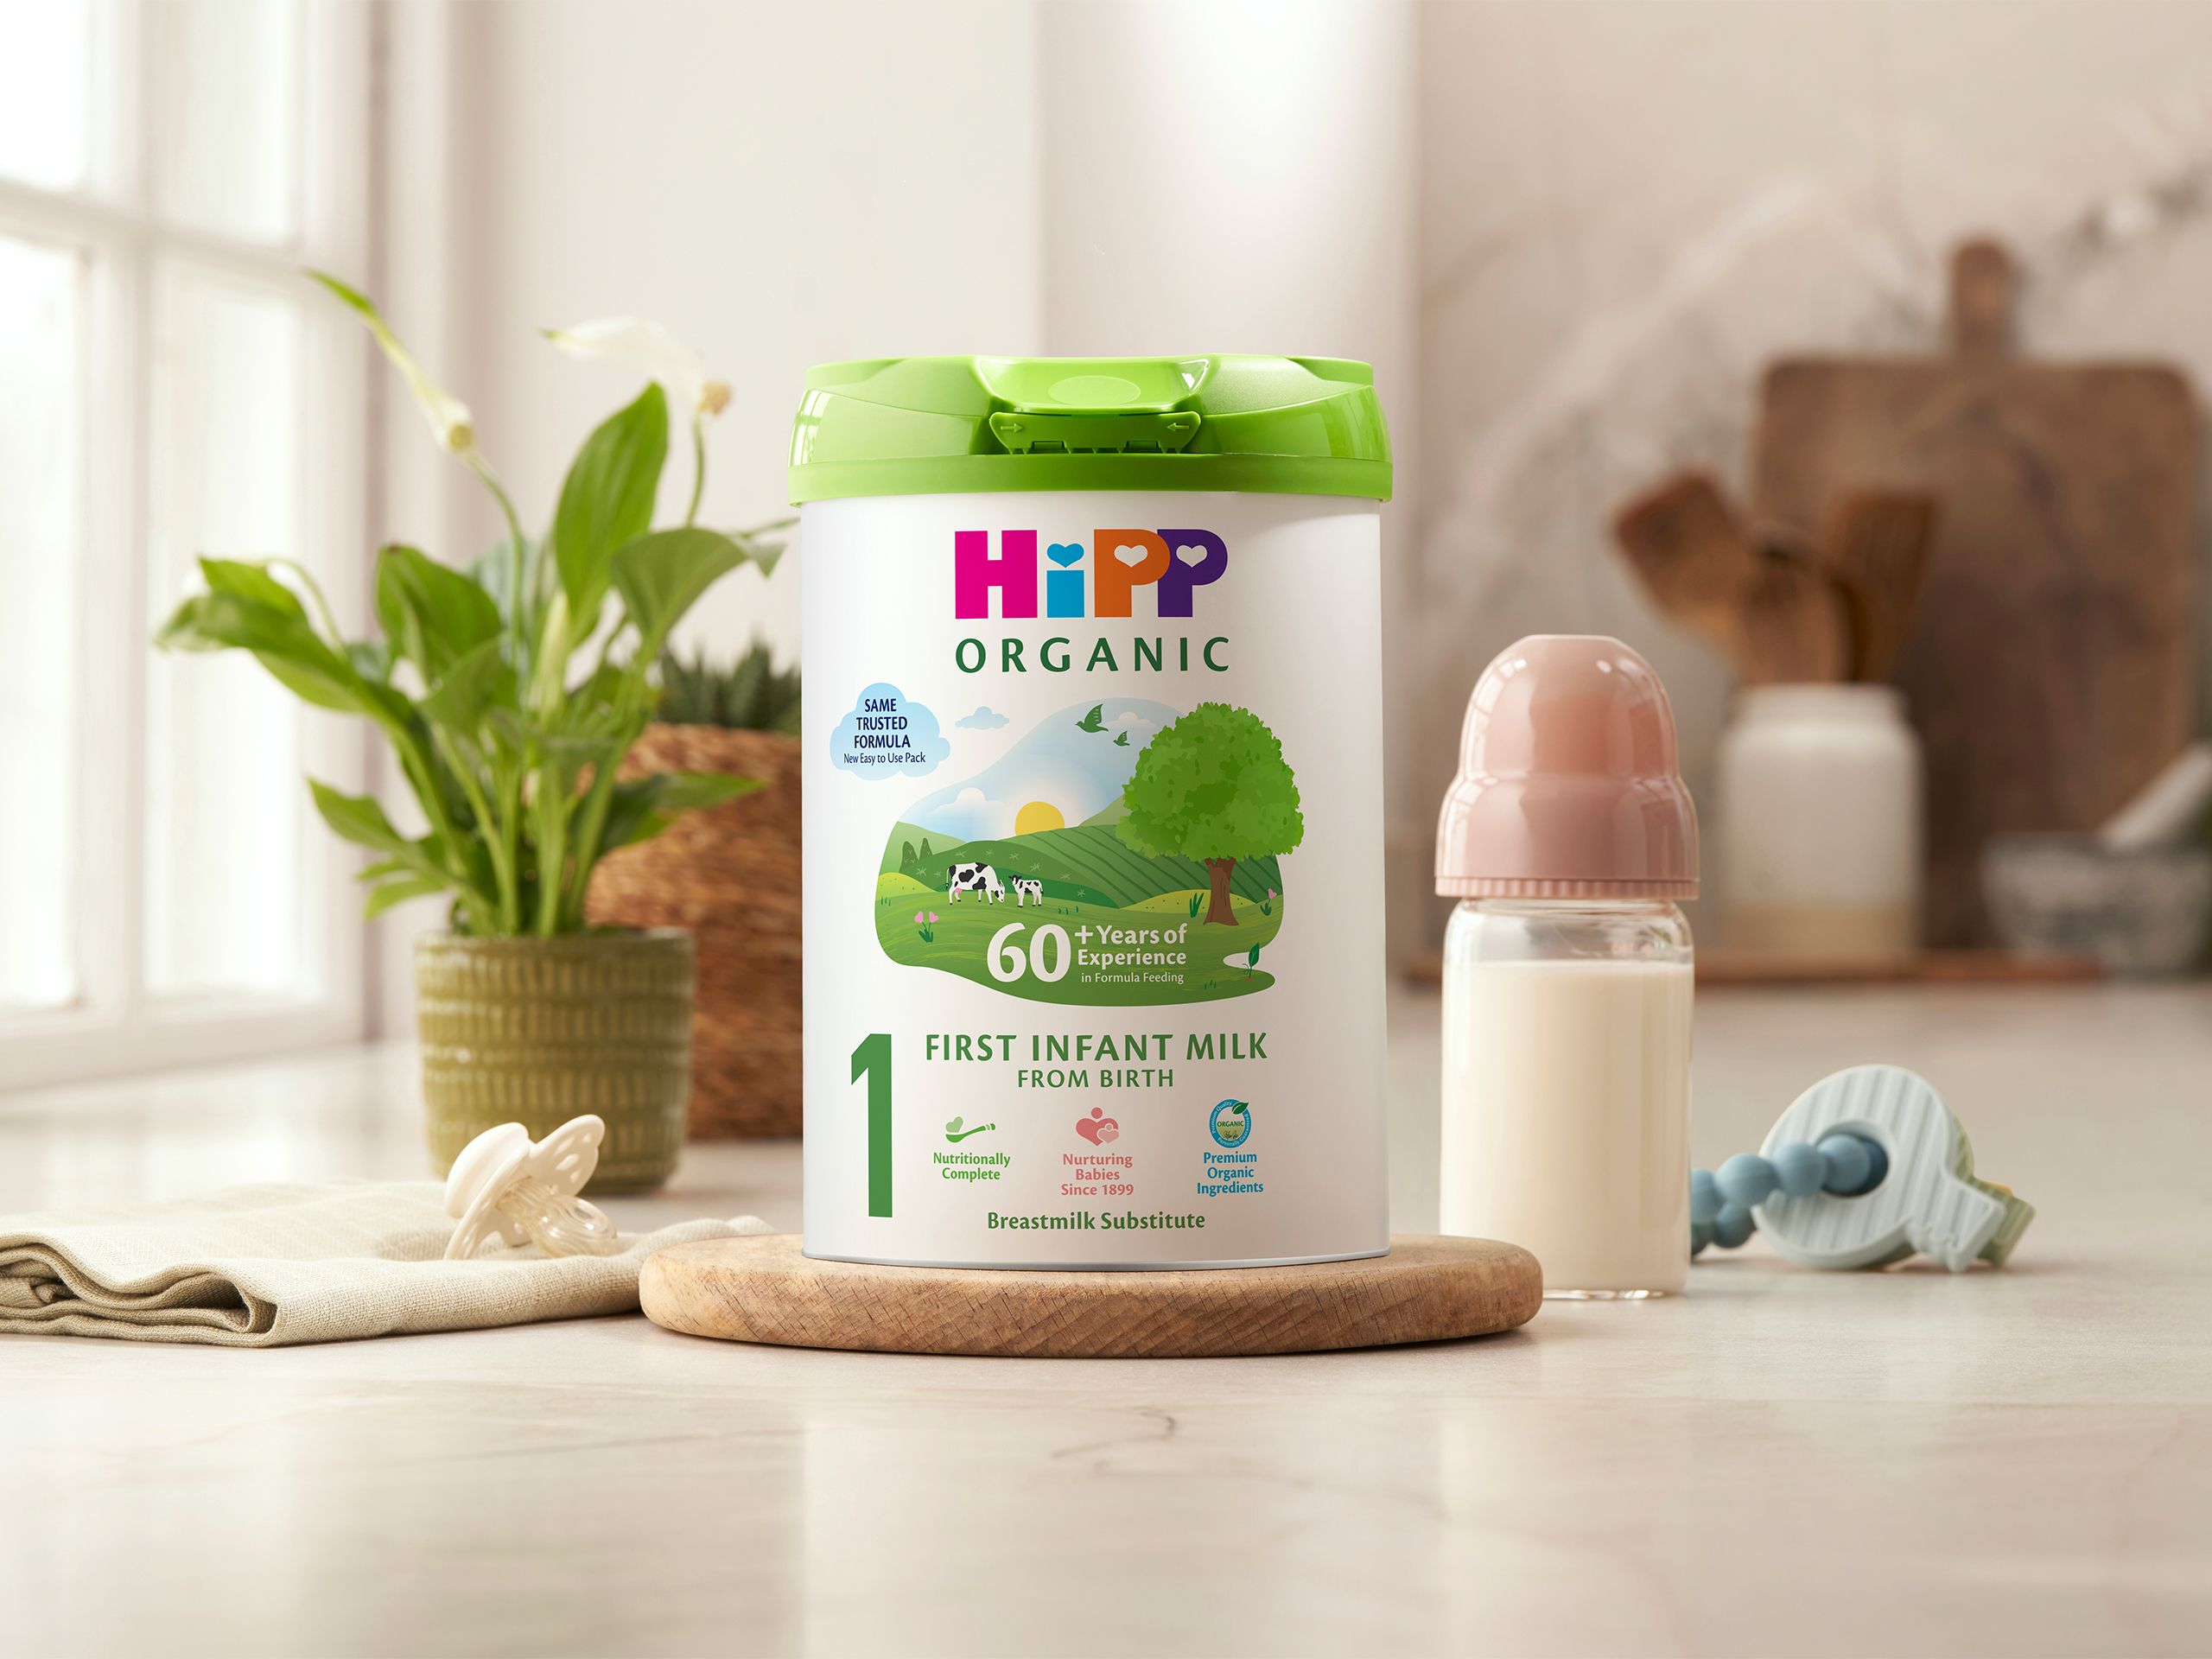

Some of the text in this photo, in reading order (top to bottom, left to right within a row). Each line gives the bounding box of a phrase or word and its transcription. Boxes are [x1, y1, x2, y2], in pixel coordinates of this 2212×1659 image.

[955, 529, 1228, 619] HiPP
[956, 637, 1229, 673] ORGANIC
[865, 698, 897, 712] SAME
[856, 716, 907, 730] TRUSTED
[854, 734, 911, 748] FORMULA
[843, 752, 925, 766] New Easy to Use Pack
[1163, 923, 1187, 944] of
[1077, 948, 1186, 969] Experience
[1081, 972, 1184, 984] in Formula Feeding
[925, 1033, 1268, 1061] FIRST INFANT MILK
[1018, 1069, 1173, 1088] FROM BIRTH
[851, 1033, 893, 1217] 1
[933, 1152, 1010, 1167] Nutritionally
[1063, 1154, 1133, 1168] Nurturing
[1203, 1151, 1257, 1164] Premium
[942, 1167, 1001, 1183] Complete
[1076, 1168, 1120, 1180] Babies
[1207, 1166, 1255, 1181] Organic
[1061, 1184, 1134, 1196] Since 1899
[1197, 1181, 1264, 1197] Ingredients
[988, 1211, 1205, 1230] Breastmilk Substitute
